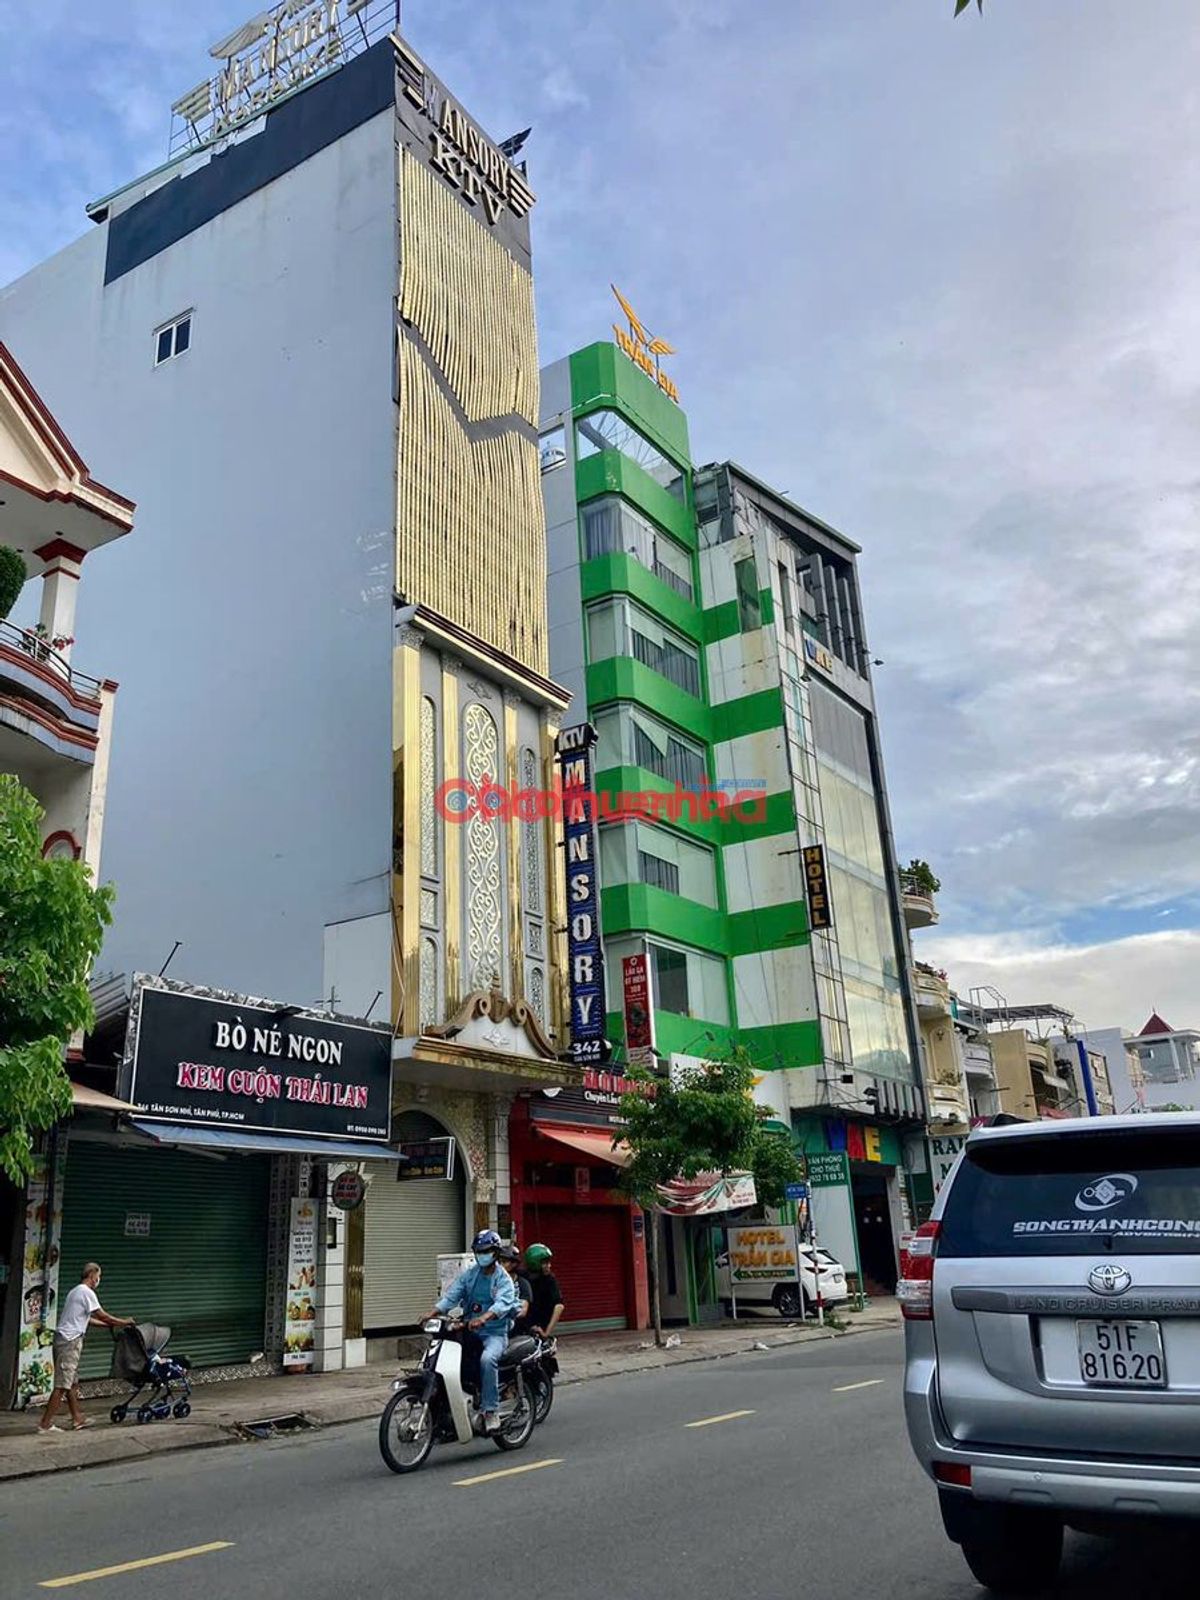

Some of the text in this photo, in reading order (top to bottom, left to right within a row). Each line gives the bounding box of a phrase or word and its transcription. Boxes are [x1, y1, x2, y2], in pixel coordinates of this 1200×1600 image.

[430, 131, 504, 226] KTV
[558, 724, 585, 751] KTV
[564, 758, 595, 1026] MANSORY
[805, 846, 827, 926] HOTEL
[216, 1015, 343, 1065] BÒ NÉ NGON
[572, 1041, 601, 1055] 342
[177, 1062, 369, 1110] KEM CUỘN THÁI LAN
[1064, 1299, 1143, 1310] CRUISER
[1096, 1325, 1138, 1351] 51F
[1083, 1352, 1161, 1381] 816.20
